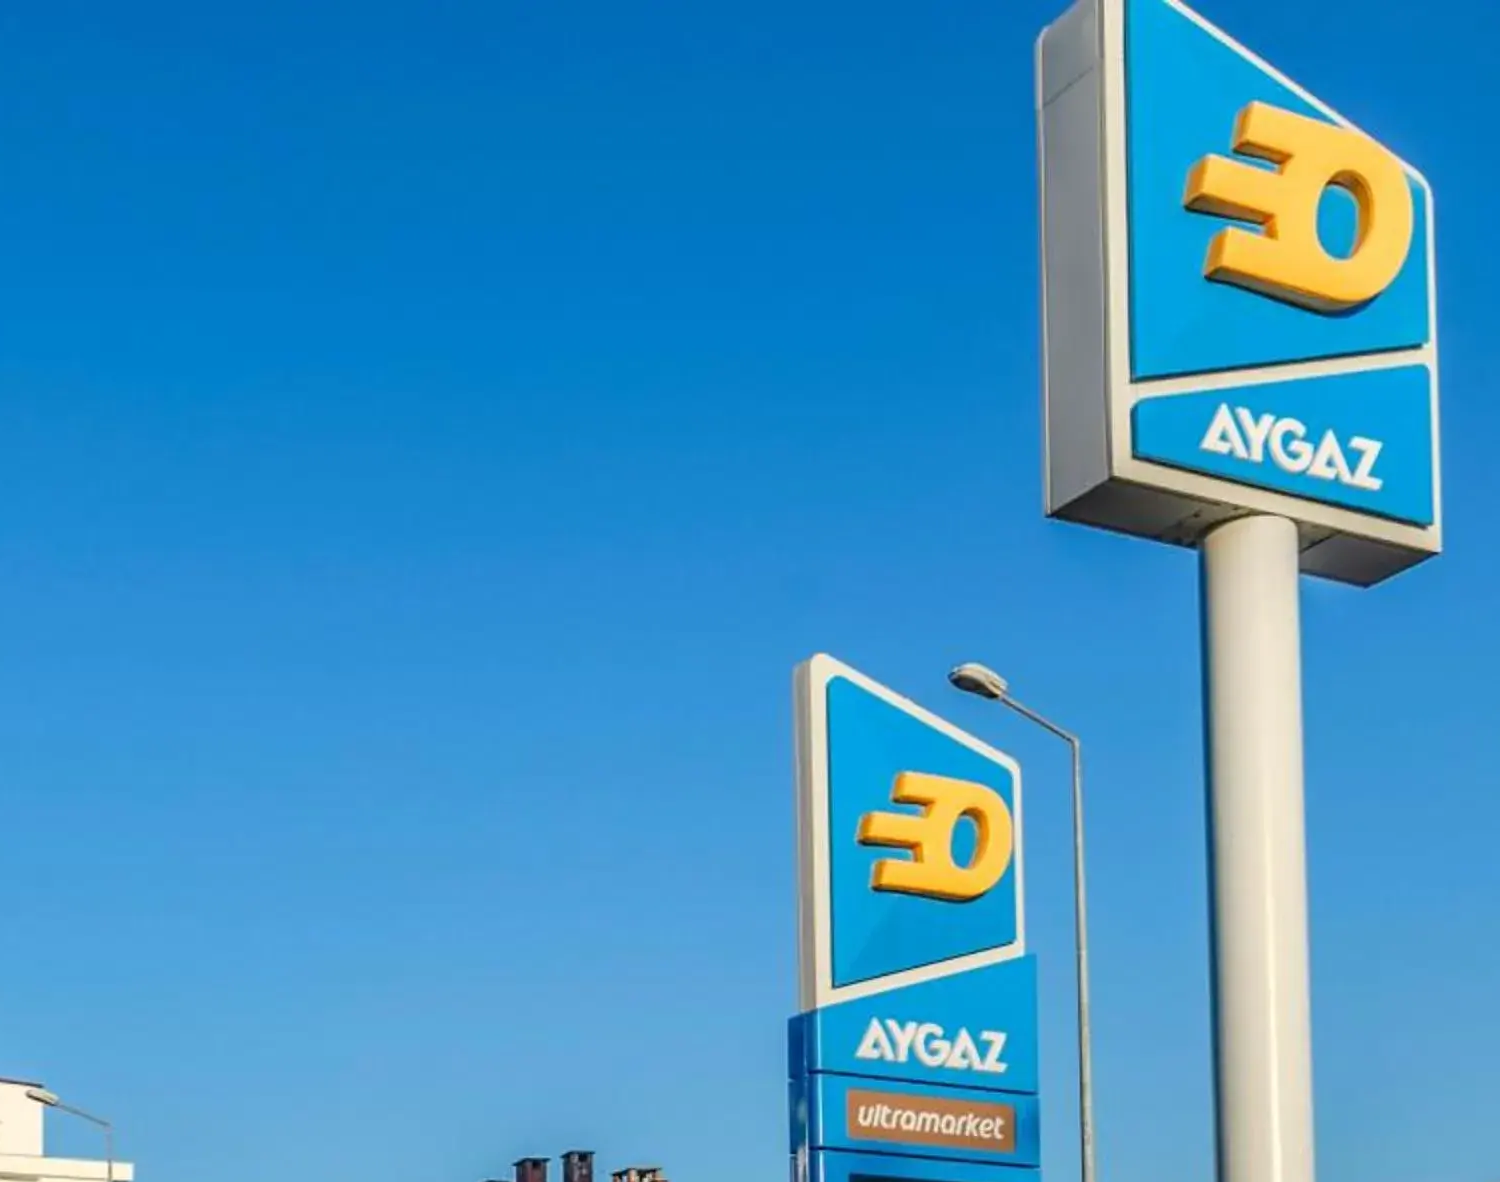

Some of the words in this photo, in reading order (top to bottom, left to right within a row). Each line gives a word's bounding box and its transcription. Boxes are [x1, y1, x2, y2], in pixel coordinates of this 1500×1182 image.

[1200, 402, 1383, 491] AYGAZ
[855, 1016, 1008, 1073] AYGAZ
[858, 1103, 1005, 1139] ultramarket
